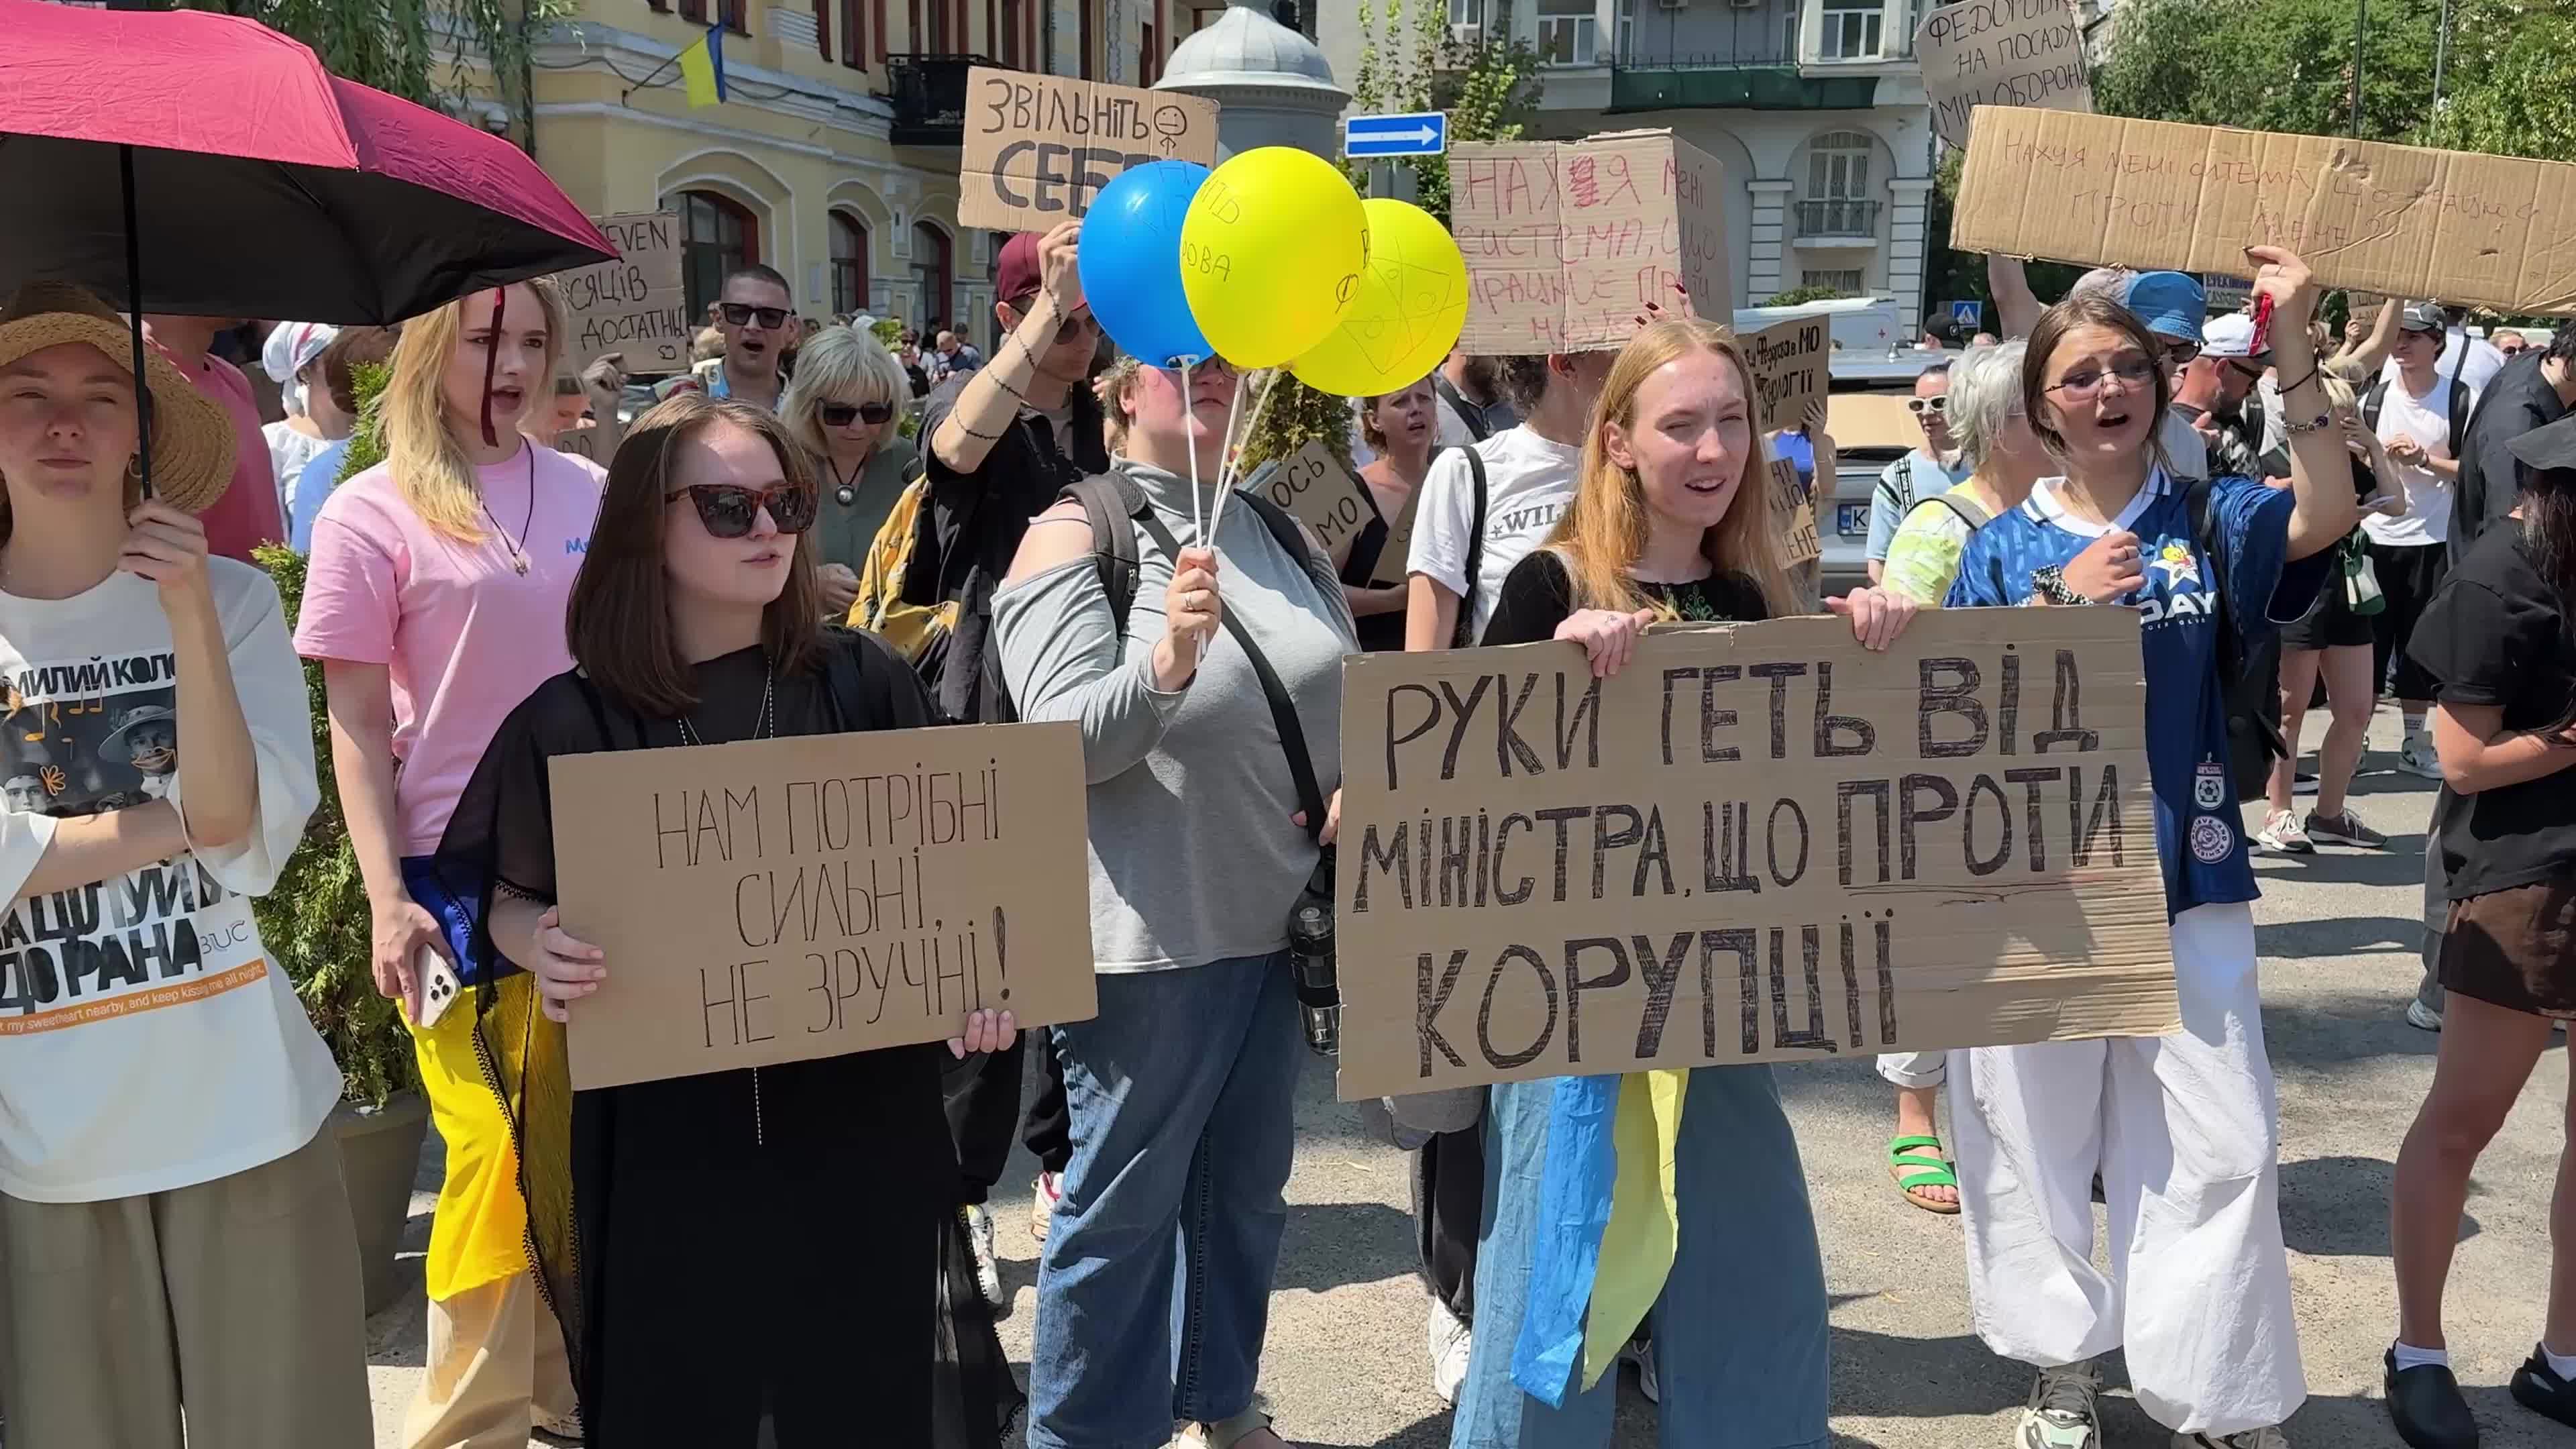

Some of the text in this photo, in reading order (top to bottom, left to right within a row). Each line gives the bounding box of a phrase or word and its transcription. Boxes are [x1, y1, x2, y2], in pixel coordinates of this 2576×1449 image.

[1953, 22, 2074, 78] НА ПОСАДУ
[982, 78, 1148, 140] ЗВІЛЬНІТЬ
[992, 140, 1184, 219] СЕБ
[599, 219, 669, 251] EVEN
[1799, 325, 1819, 354] МО
[1784, 524, 1823, 559] ЕНЕ
[1386, 643, 2099, 791] РУКИ ГЕТЬ ВІД
[653, 757, 1000, 868] НАМ ПОТРІБНІ
[1354, 764, 2125, 912] МІНІСТРА, ЩО ПРОТИ
[736, 847, 943, 947] СИЛЬНІ,
[60, 918, 203, 998] РАНА
[1417, 909, 1897, 1079] КОРУПЦІЇ
[7, 1020, 25, 1032] my
[27, 1008, 84, 1029] sweetheart
[86, 1002, 127, 1018] nearby,
[129, 994, 149, 1009] and
[152, 989, 180, 1004] keep
[209, 979, 223, 992] me
[225, 973, 237, 986] all
[700, 959, 775, 1047] НЕ
